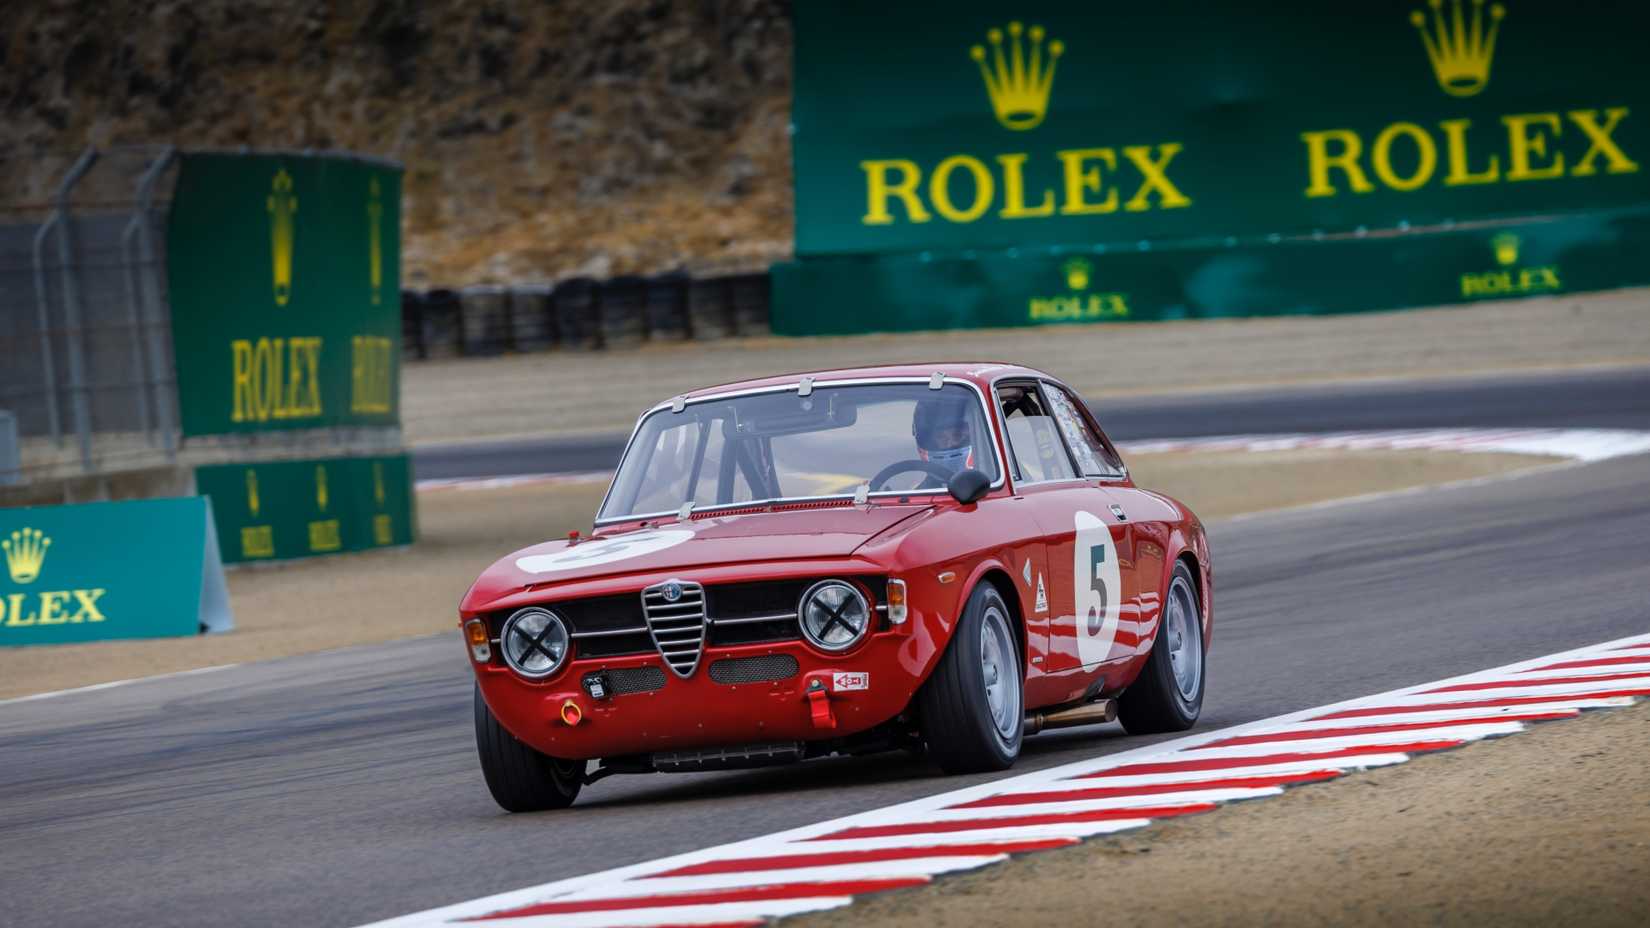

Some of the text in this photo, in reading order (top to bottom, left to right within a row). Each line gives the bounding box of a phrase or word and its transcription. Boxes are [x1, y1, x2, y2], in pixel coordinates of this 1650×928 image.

[862, 143, 1190, 225] ROLEX
[1303, 107, 1638, 198] ROLEX
[231, 337, 322, 423] ROLEX
[0, 588, 106, 626] LEX
[1088, 544, 1107, 637] 5
